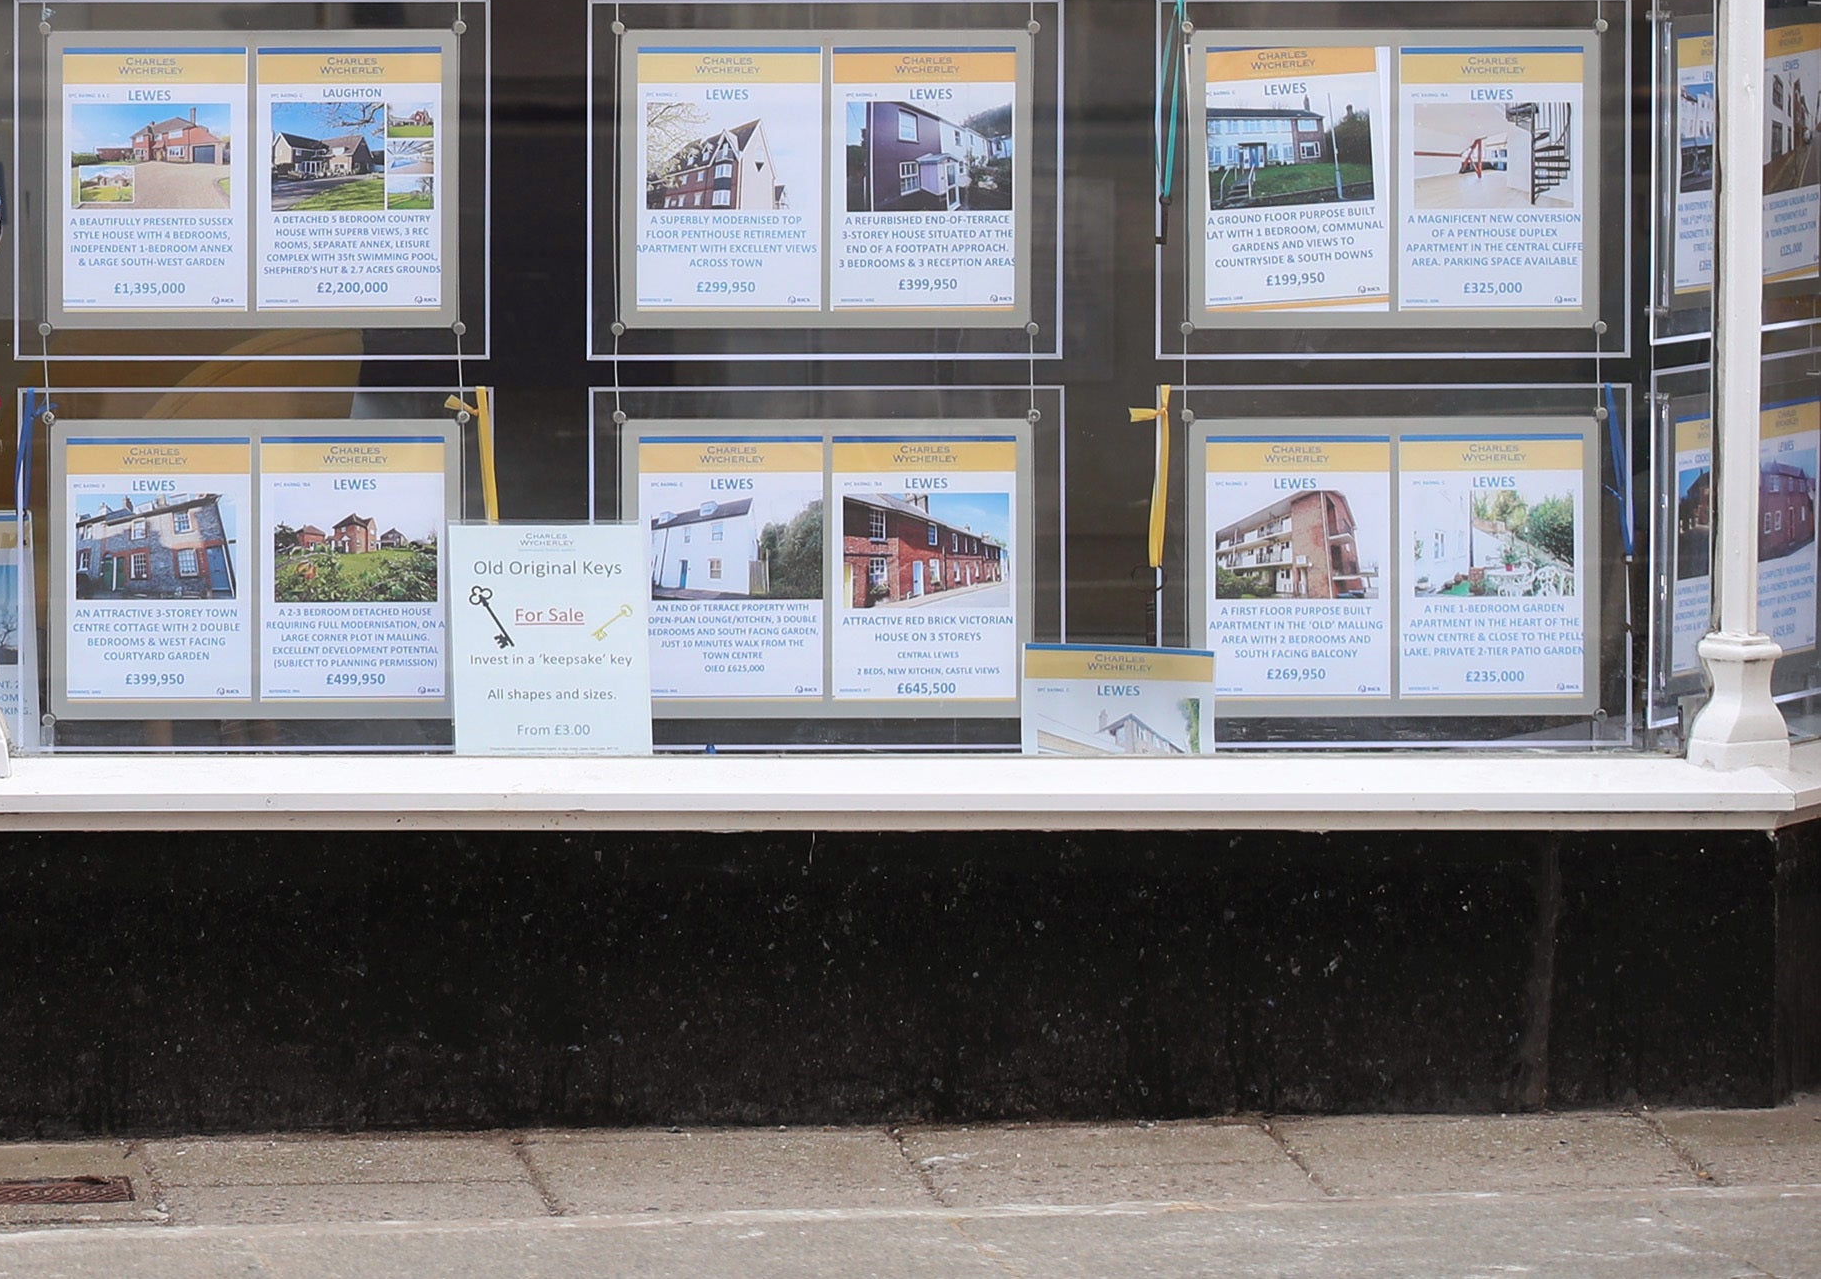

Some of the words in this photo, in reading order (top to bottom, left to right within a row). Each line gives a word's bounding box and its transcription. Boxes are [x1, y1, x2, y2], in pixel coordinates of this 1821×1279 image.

[128, 90, 171, 101] LEWES
[323, 88, 381, 98] LAUGHTON
[706, 89, 748, 100] LEWES
[909, 89, 952, 100] LEWES
[1264, 84, 1307, 96] LEWES
[1471, 89, 1513, 100] LEWES
[690, 259, 728, 267] ACROSS
[731, 259, 762, 267] TOWN
[899, 278, 957, 291] £399,950
[1267, 272, 1325, 286] £199,950
[115, 283, 185, 296] £1,395,000
[317, 282, 388, 295] £2,200,000
[697, 282, 755, 294] £299,950
[1464, 282, 1522, 295] £325,000
[133, 480, 175, 491] LEWES
[334, 479, 376, 490] LEWES
[711, 479, 753, 490] LEWES
[905, 478, 948, 489] LEWES
[1274, 478, 1317, 489] LEWES
[1473, 476, 1515, 487] LEWES
[520, 538, 574, 546] WYCHERLEY
[474, 561, 503, 575] Old
[509, 560, 576, 578] Original
[583, 561, 622, 578] Keys
[516, 609, 543, 621] For
[549, 608, 583, 621] Sale
[875, 633, 908, 642] HOUSE
[912, 633, 927, 641] ON
[930, 633, 935, 641] 3
[938, 632, 981, 641] STOREYS
[104, 652, 165, 660] COURTYARD
[168, 652, 209, 660] GARDEN
[1095, 654, 1145, 663] CHARLES
[1235, 650, 1269, 658] SOUTH
[1272, 650, 1308, 658] FACING
[1311, 649, 1358, 658] BALCONY
[471, 655, 508, 665] Invest
[513, 654, 523, 664] in
[611, 654, 632, 667] key
[1088, 662, 1152, 672] WYCHERLEY
[126, 674, 184, 686] £399,950
[327, 674, 385, 686] £499,950
[1267, 668, 1326, 681] £269,950
[1466, 671, 1524, 682] £235,000
[898, 683, 956, 695] £645,500
[1098, 685, 1140, 696] LEWES
[488, 688, 503, 699] All
[508, 689, 552, 702] shapes
[556, 688, 579, 699] and
[584, 689, 616, 699] sizes.
[518, 724, 550, 735] From
[555, 724, 590, 737] £3.00
